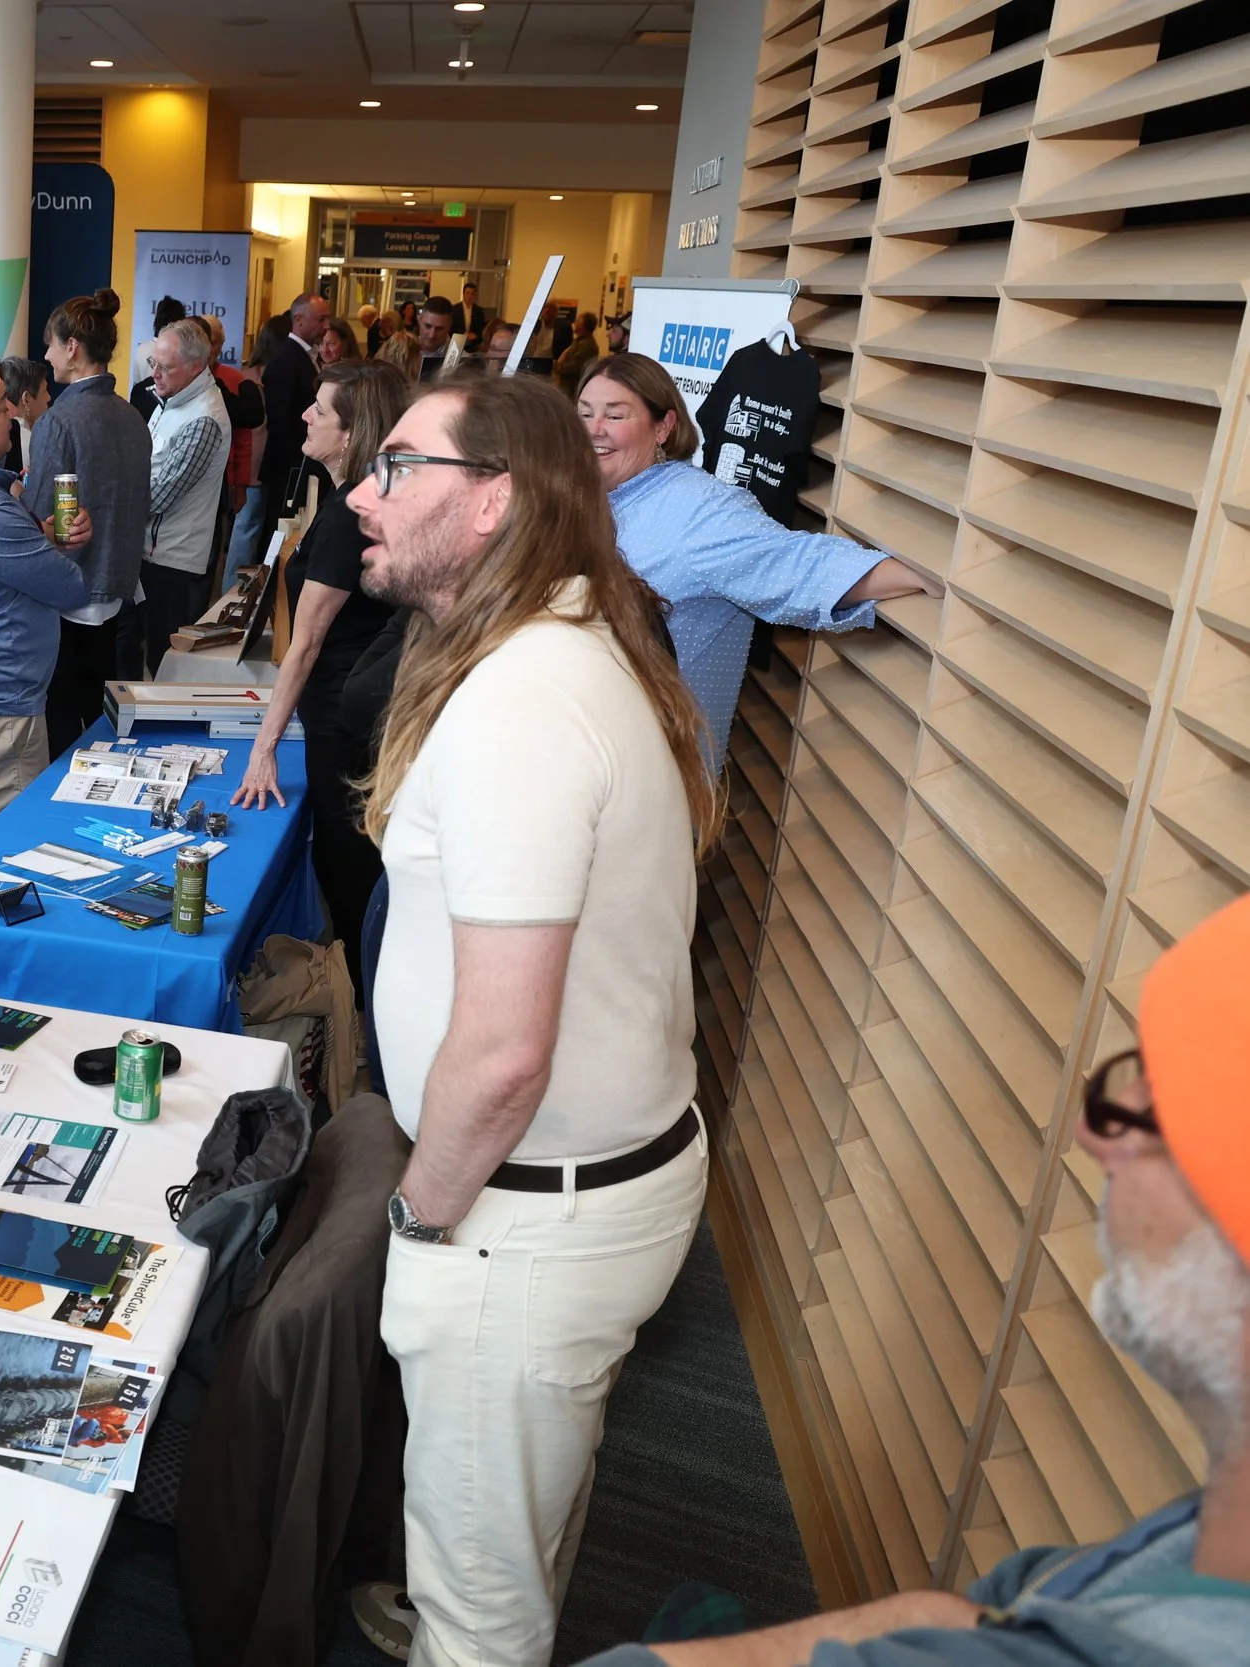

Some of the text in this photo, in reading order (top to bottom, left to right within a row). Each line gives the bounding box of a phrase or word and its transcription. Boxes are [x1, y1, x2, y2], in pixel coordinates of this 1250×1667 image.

[690, 156, 723, 194] ANTHEM
[384, 232, 440, 241] Parking Garage
[385, 243, 409, 252] Levels
[417, 244, 430, 252] and
[151, 249, 231, 265] LAUNCHPAD
[662, 331, 727, 361] STARC
[760, 403, 779, 416] wasn't
[778, 406, 793, 420] built
[147, 1257, 167, 1274] The
[3, 1583, 34, 1626] cocci
[21, 1586, 52, 1630] luciano
